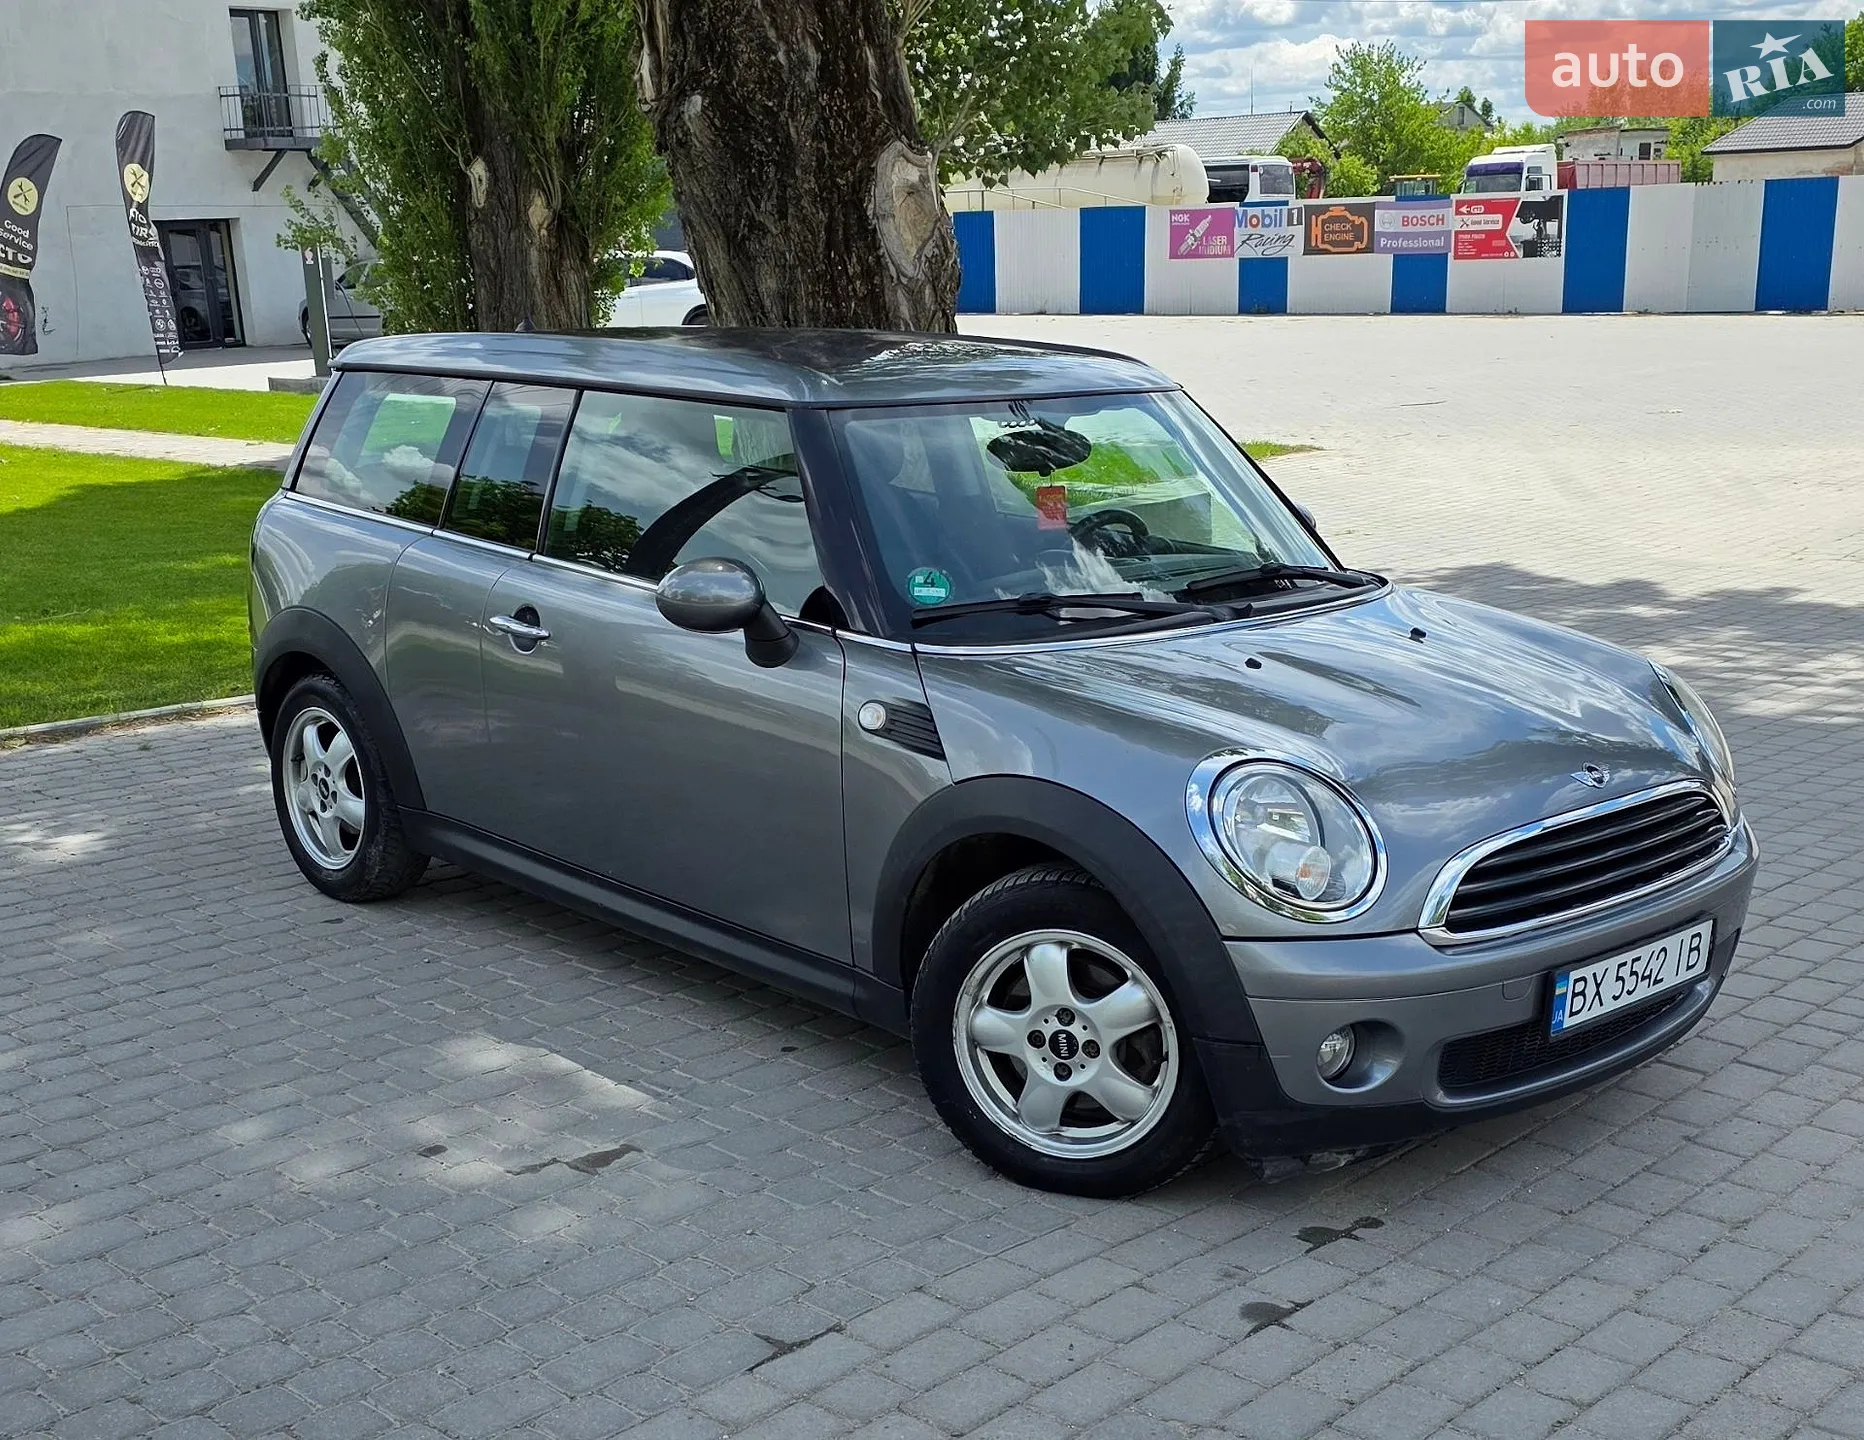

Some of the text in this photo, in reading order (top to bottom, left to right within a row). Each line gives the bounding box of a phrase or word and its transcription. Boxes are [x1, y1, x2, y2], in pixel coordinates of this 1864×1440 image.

[1235, 208, 1298, 228] Mobil 1
[1401, 213, 1445, 227] BOSCH
[4, 220, 30, 239] Good
[1324, 222, 1352, 231] CHECK
[1234, 233, 1296, 256] Racing
[1324, 232, 1356, 241] ENGINE
[1380, 236, 1445, 248] Professional
[924, 571, 936, 587] 4
[1568, 967, 1609, 1019] BX
[1612, 946, 1668, 1001] 5542
[1552, 1009, 1564, 1024] UA
[1058, 1034, 1069, 1056] MINI
